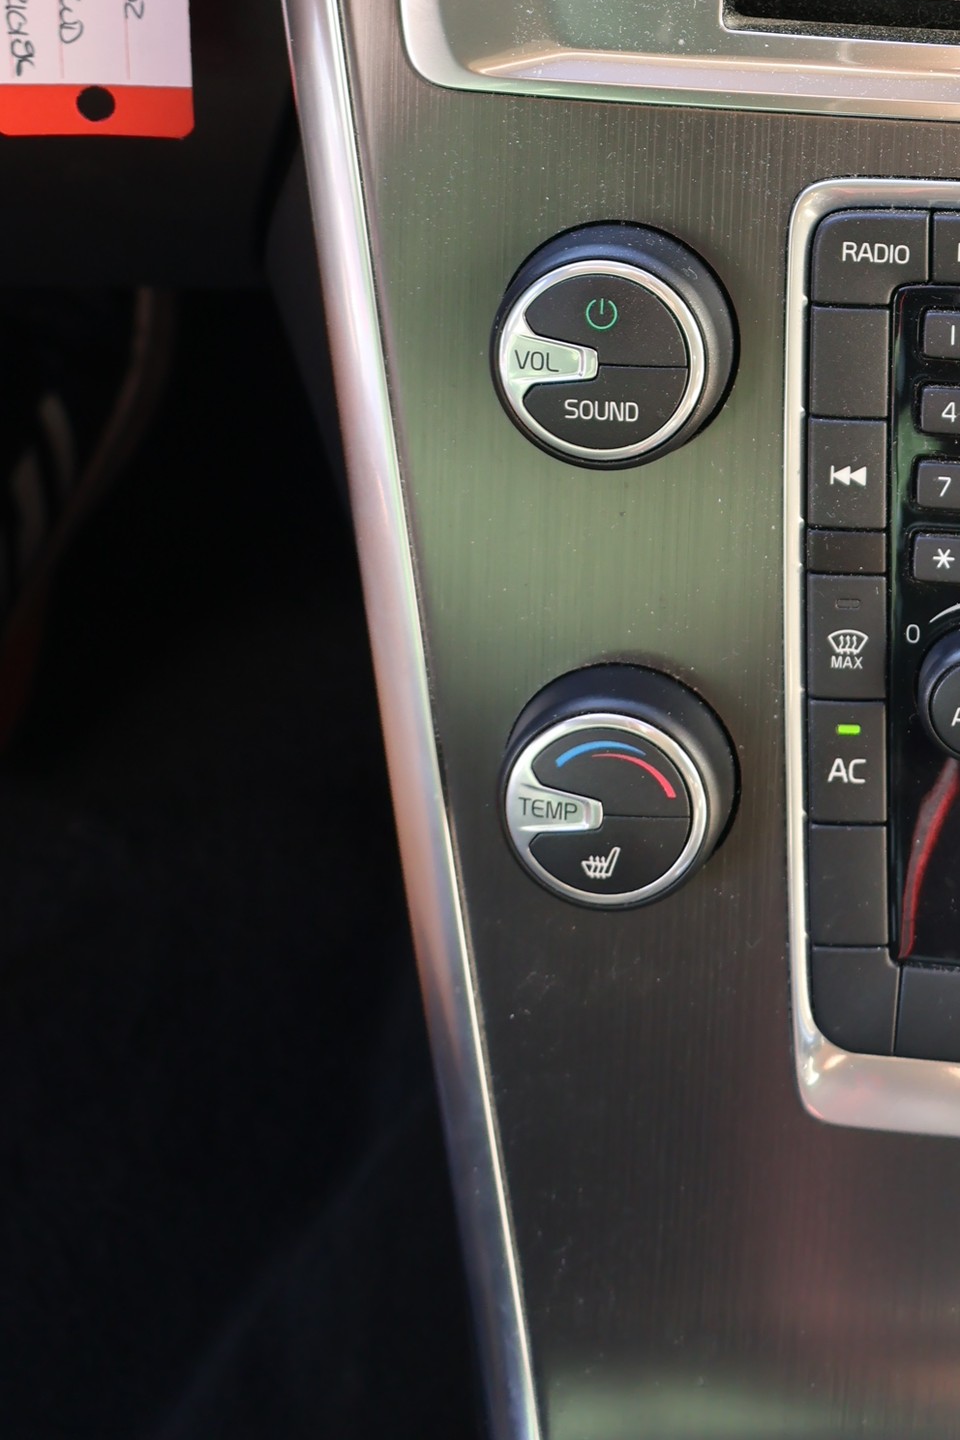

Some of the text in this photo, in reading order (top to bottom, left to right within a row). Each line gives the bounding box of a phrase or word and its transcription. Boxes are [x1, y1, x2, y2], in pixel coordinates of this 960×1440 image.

[841, 241, 911, 265] RADIO
[514, 349, 559, 372] VOL
[564, 399, 639, 422] SOUND
[941, 402, 957, 423] 4
[937, 476, 952, 497] 7
[830, 655, 863, 669] MAX
[827, 758, 867, 784] AC
[518, 796, 578, 820] TEMP
